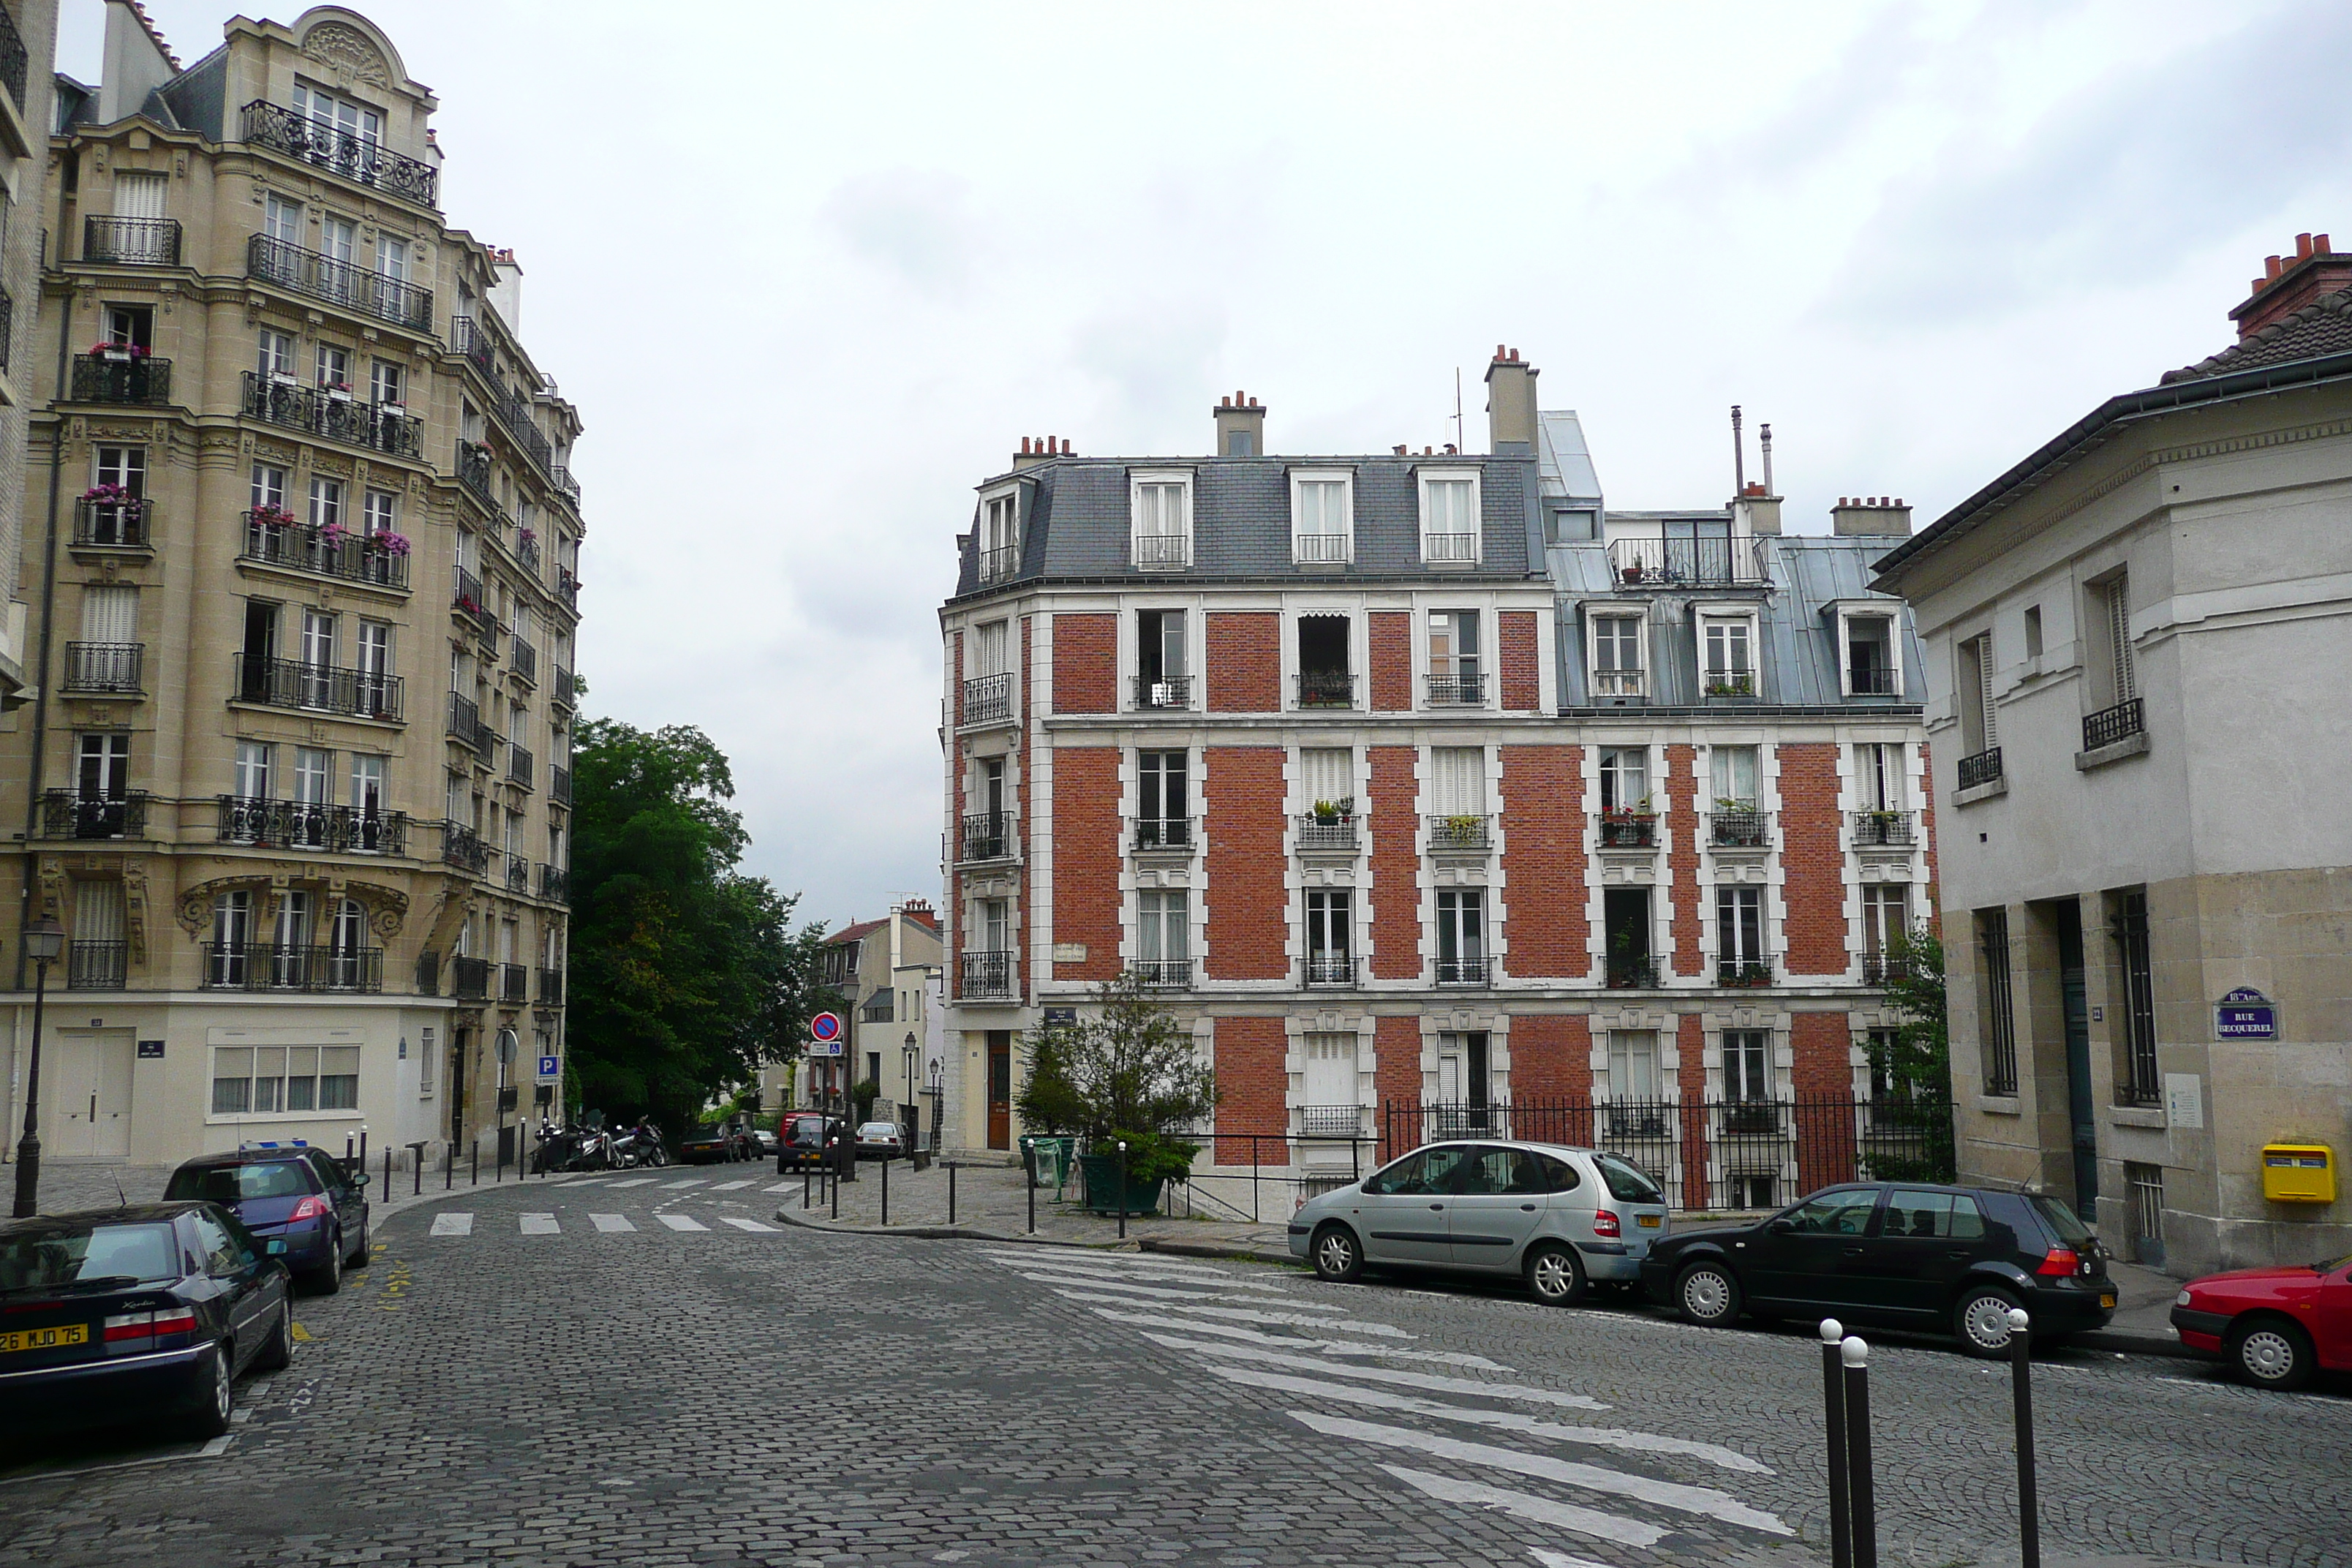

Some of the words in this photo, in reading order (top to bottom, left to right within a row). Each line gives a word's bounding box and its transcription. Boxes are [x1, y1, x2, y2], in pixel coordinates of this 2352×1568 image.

[2235, 1013, 2255, 1021] RUE
[2218, 1024, 2273, 1033] BECQUEREL
[543, 1059, 553, 1073] P
[28, 1330, 56, 1347] MJD
[62, 1327, 81, 1343] 75
